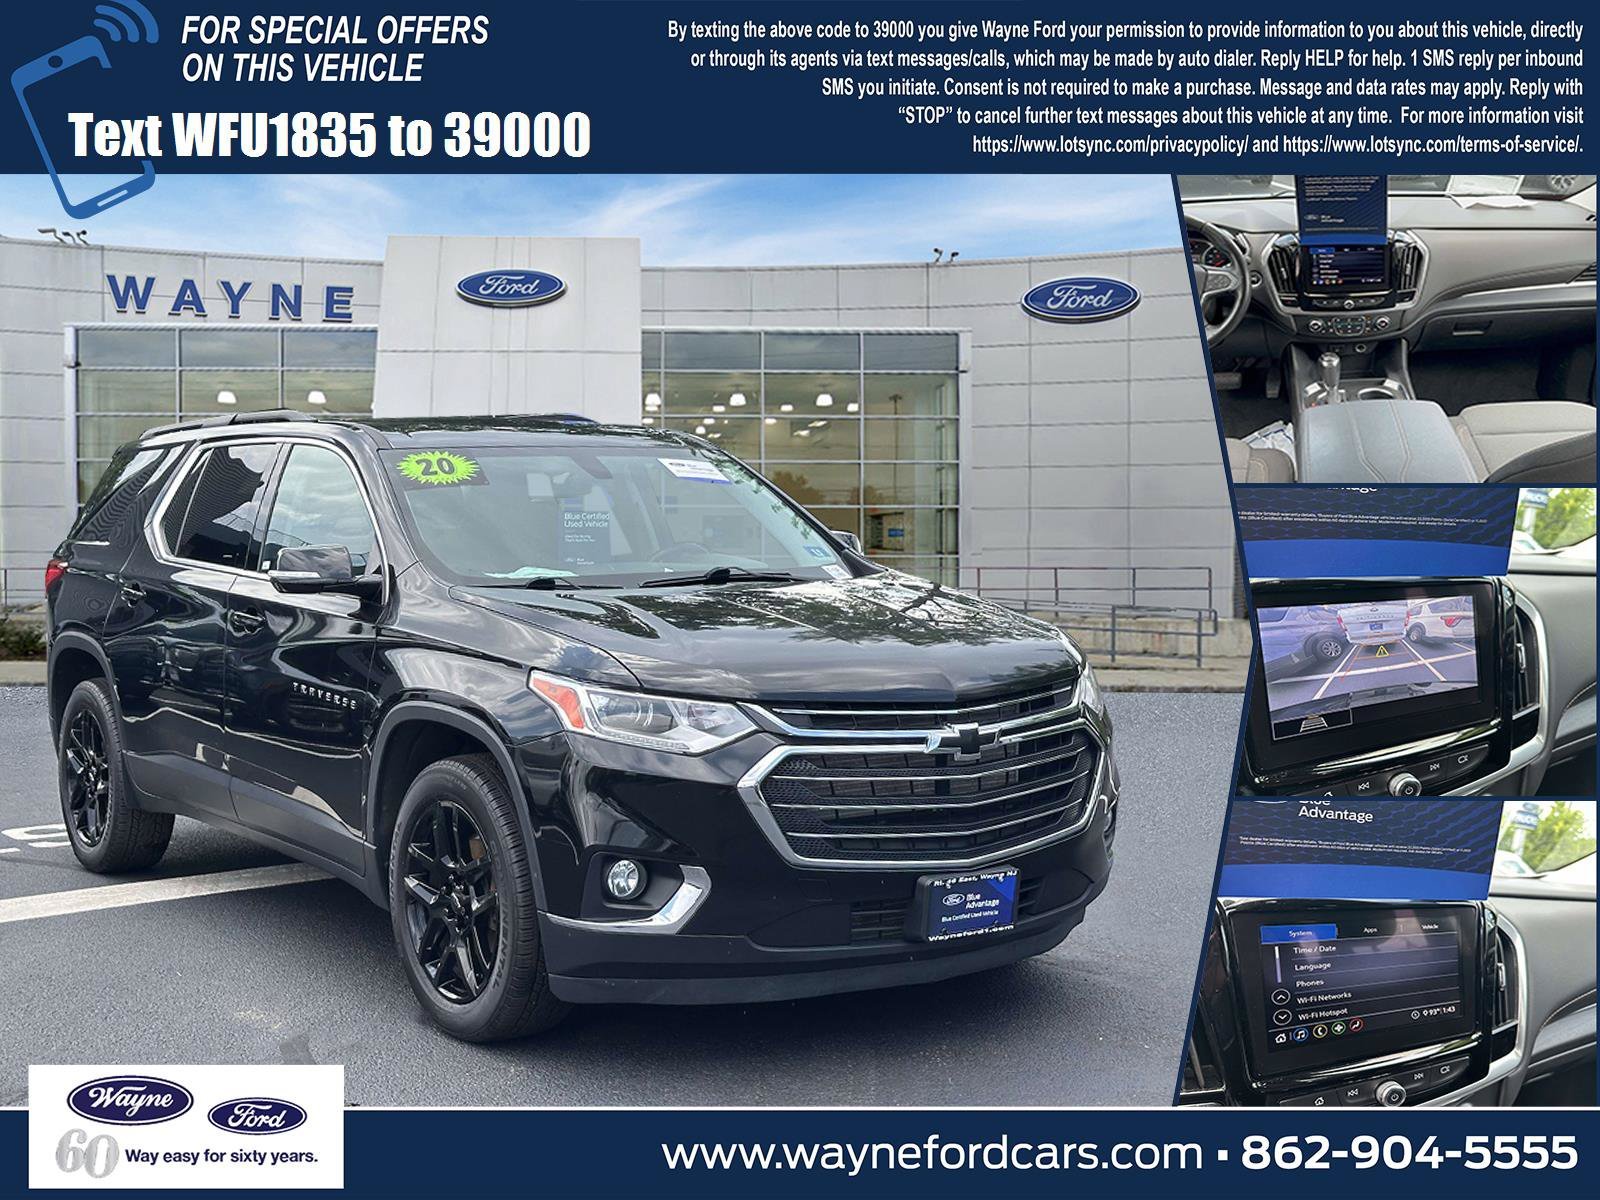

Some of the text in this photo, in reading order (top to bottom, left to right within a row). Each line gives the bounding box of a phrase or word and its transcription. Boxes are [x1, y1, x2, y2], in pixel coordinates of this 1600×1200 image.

[479, 275, 540, 295] Ford
[106, 273, 355, 322] WAYNE
[1046, 285, 1114, 309] Ford
[415, 457, 455, 476] 20
[292, 682, 357, 710] TRAVERSE
[1298, 805, 1374, 824] Advantage
[966, 892, 981, 901] Blue
[965, 899, 1000, 909] Advantage
[928, 924, 1015, 942] Wayneford1.com
[1288, 929, 1313, 938] System
[1363, 926, 1378, 934] Apps
[1292, 945, 1313, 954] Time
[1319, 944, 1337, 953] Date
[1294, 961, 1332, 972] Language
[1296, 978, 1325, 988] Phones
[1296, 991, 1352, 1005] Wi-Fi Networks
[1298, 1007, 1349, 1022] Wi-Fi Hotspot
